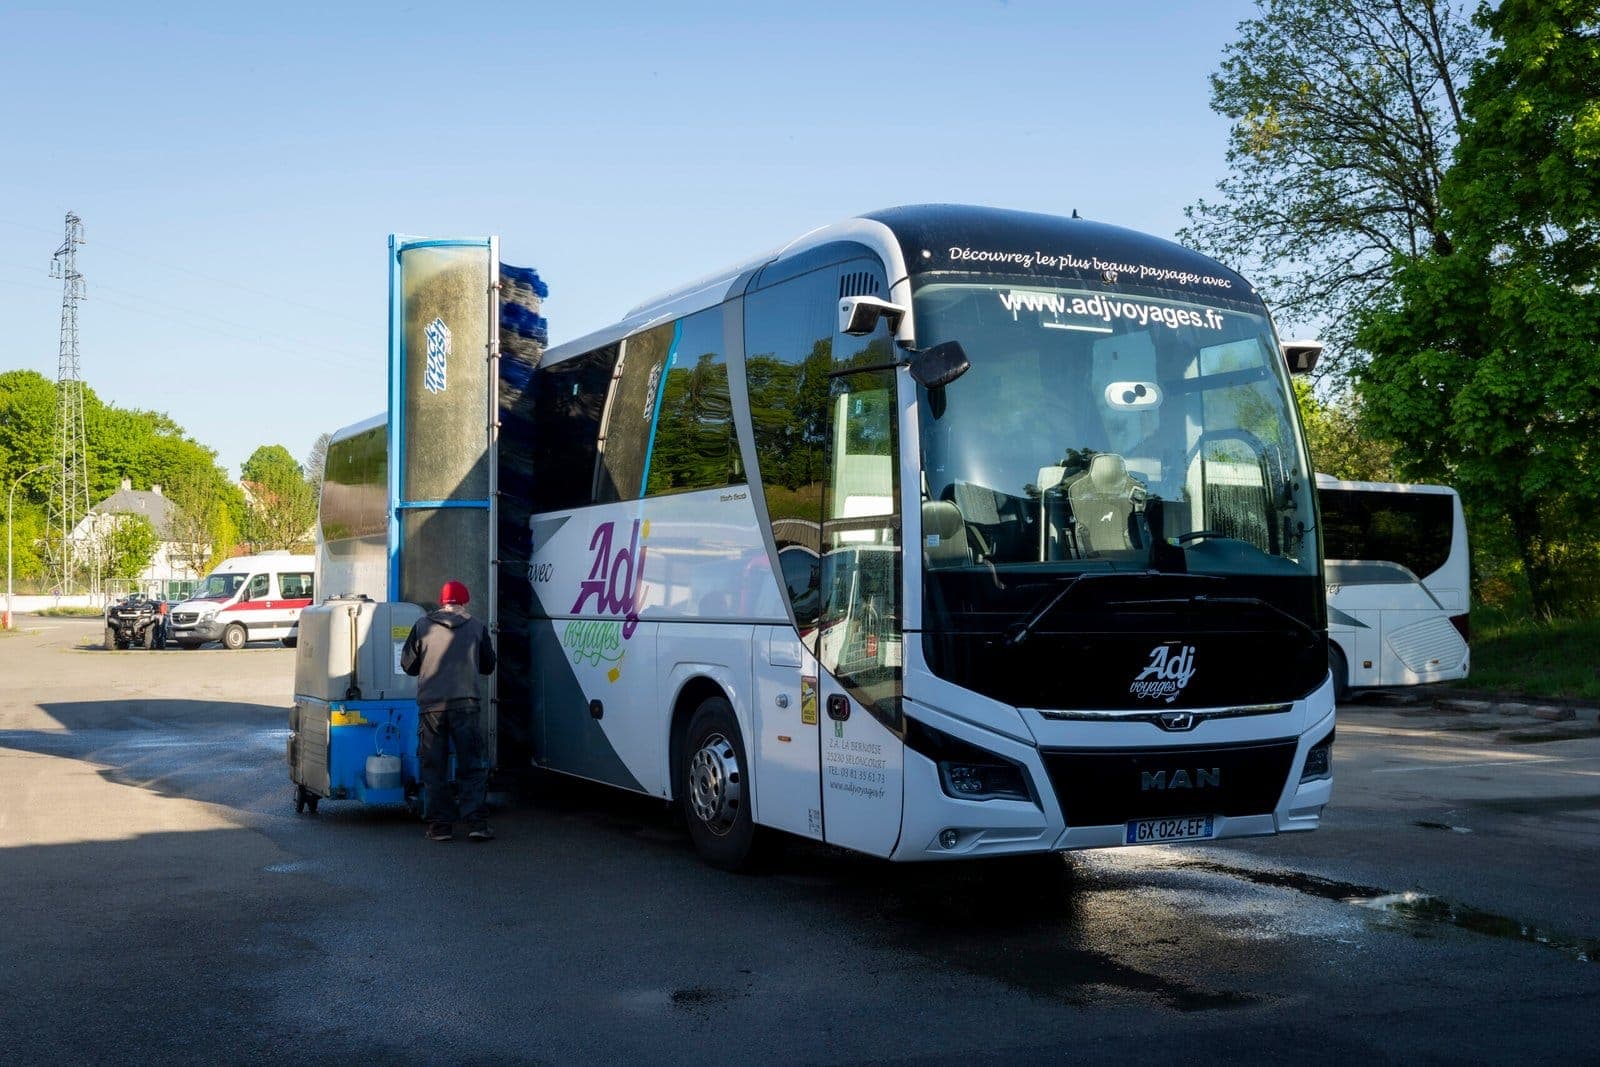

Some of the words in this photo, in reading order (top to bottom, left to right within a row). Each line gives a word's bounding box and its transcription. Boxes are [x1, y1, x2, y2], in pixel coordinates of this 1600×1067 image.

[949, 247, 1034, 268] Découvrez
[1035, 251, 1057, 267] les
[1058, 254, 1091, 271] plus
[1092, 257, 1139, 274] beaux
[1140, 264, 1200, 284] paysages
[1202, 275, 1232, 289] avec
[1000, 293, 1223, 330] www.adjvoyages.fr
[570, 518, 651, 640] Adj
[563, 619, 625, 667] voyages
[1134, 645, 1196, 688] Adj
[1129, 680, 1176, 698] voyages
[1141, 768, 1220, 791] MAN
[1138, 818, 1204, 840] GX-024-EF
